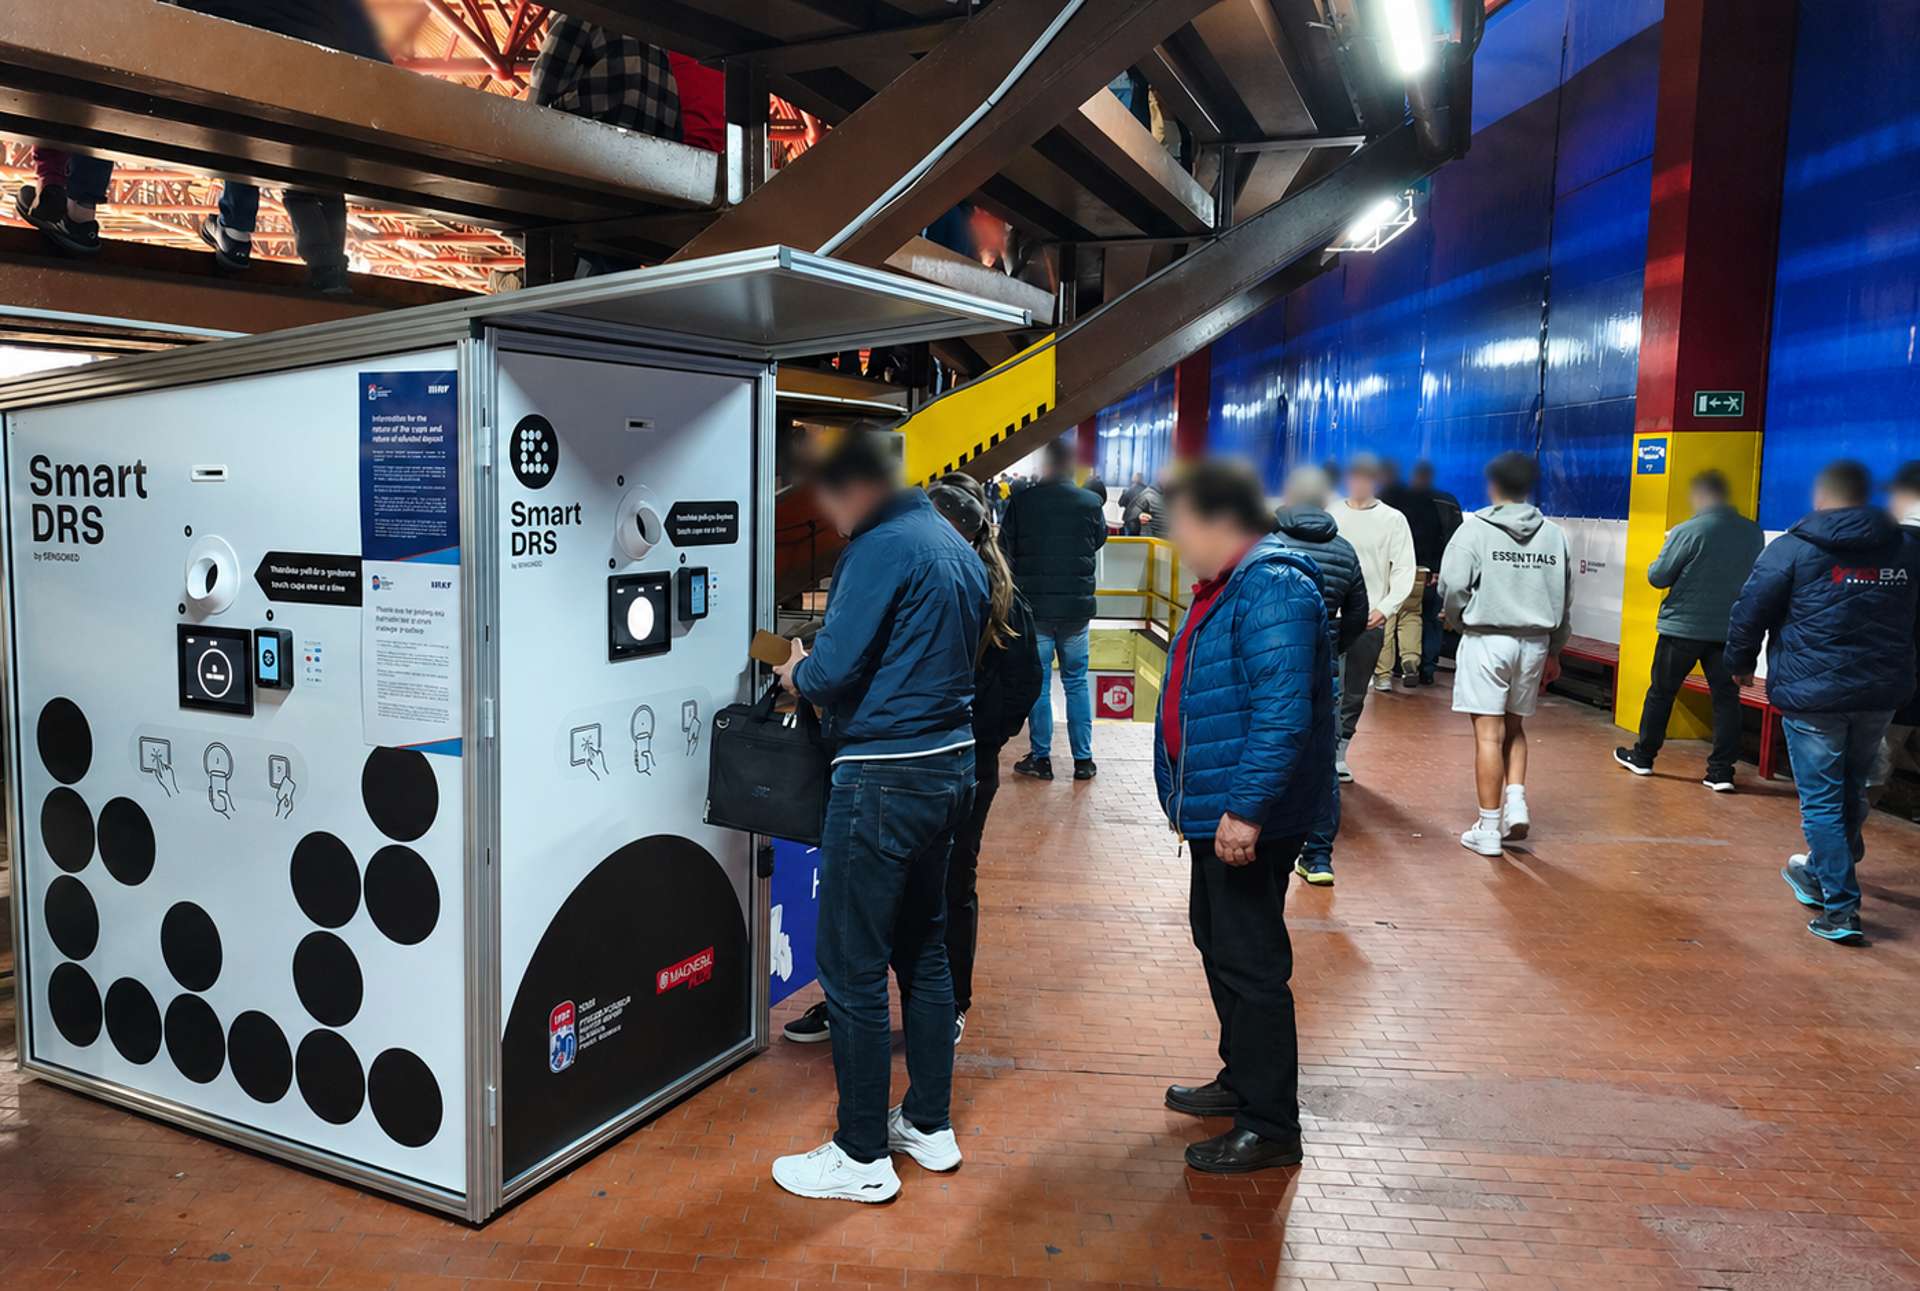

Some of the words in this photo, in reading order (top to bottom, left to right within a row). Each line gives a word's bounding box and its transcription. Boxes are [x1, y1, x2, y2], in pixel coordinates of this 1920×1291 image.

[30, 454, 147, 499] Smart
[32, 503, 104, 545] DRS
[511, 501, 582, 527] Smart
[511, 530, 557, 557] DRS
[1492, 551, 1557, 566] ESSENTIALS
